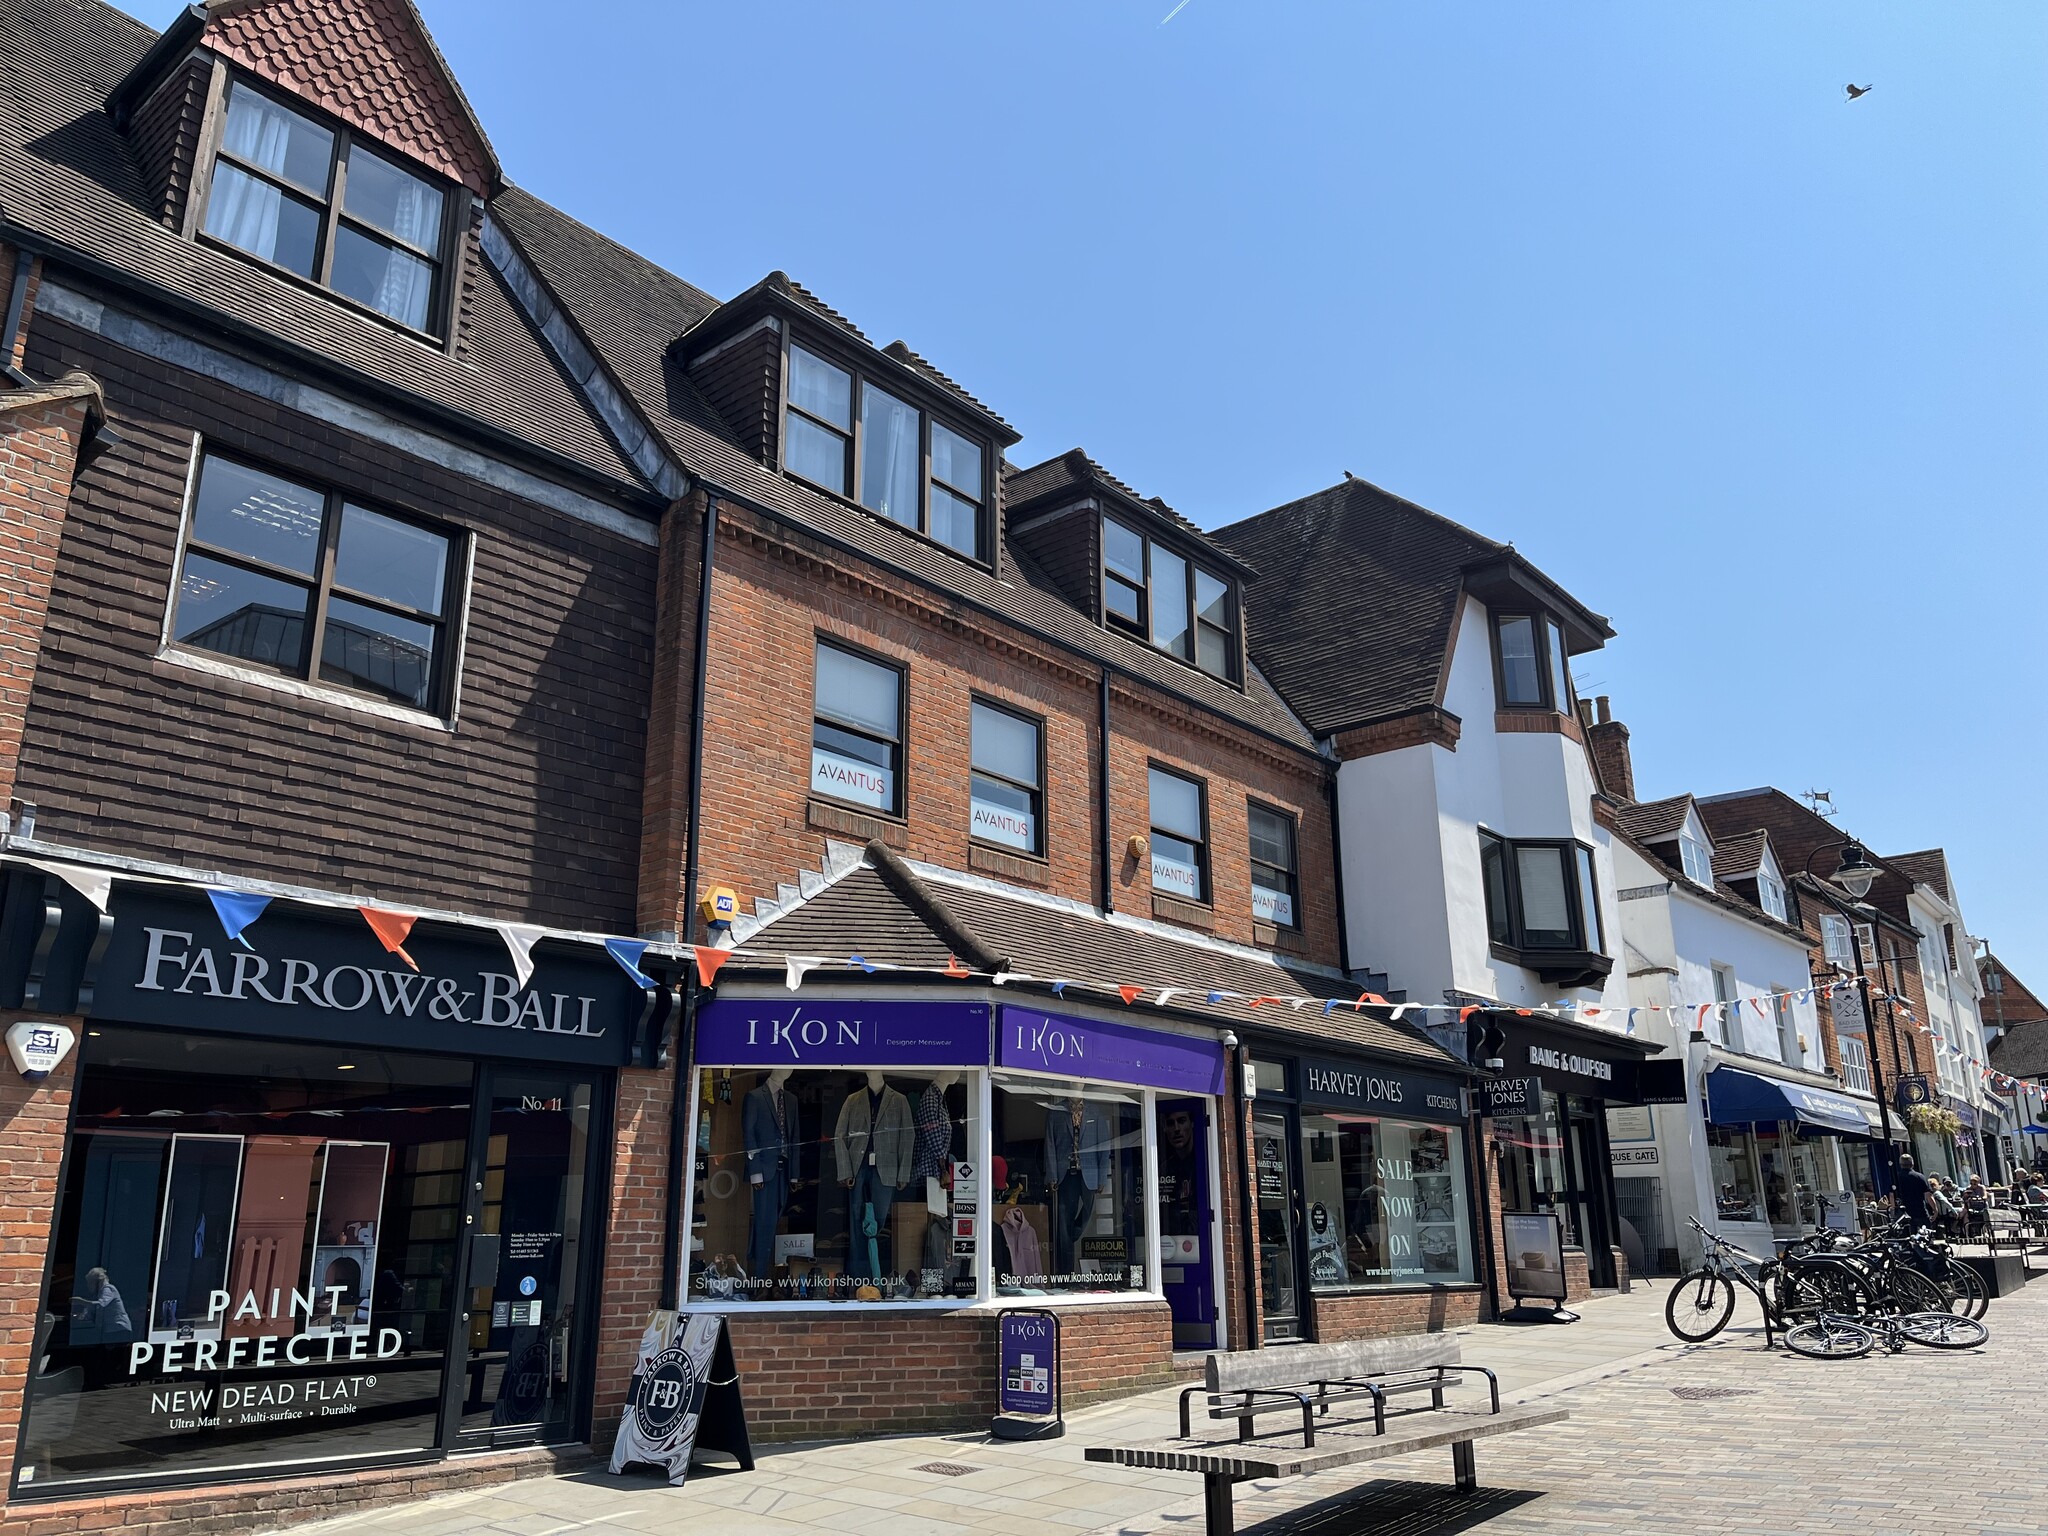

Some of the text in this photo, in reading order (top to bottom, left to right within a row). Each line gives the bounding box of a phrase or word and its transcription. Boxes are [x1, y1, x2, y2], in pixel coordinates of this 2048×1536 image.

[817, 763, 885, 794] AVANTUS
[974, 809, 1028, 837] AVANTUS
[1153, 864, 1195, 886] AVANTUS
[717, 898, 733, 910] ADT
[1252, 893, 1288, 914] AVANTUS
[746, 1007, 863, 1059] IKON
[886, 1038, 952, 1047] Designer Menswear
[1016, 1018, 1085, 1066] IKON
[1529, 1045, 1612, 1081] BANG & OLUFSEN
[1309, 1067, 1403, 1103] HARVEY JONES
[1484, 1078, 1530, 1093] HARVEY
[521, 1095, 563, 1112] No. 11
[1426, 1094, 1458, 1111] KITCHENS
[1491, 1091, 1526, 1107] JONES
[1492, 1107, 1527, 1116] KITCHENS
[1635, 1151, 1656, 1160] GATE
[1377, 1158, 1414, 1181] SALE
[955, 1204, 976, 1212] BOSS
[1380, 1196, 1414, 1218] NOW
[783, 1239, 805, 1249] SALE
[1084, 1241, 1124, 1251] BARBOUR
[1084, 1250, 1126, 1258] INTERNATIONAL
[1391, 1235, 1411, 1256] ON
[1000, 1270, 1123, 1286] Shop online www.ikonshop.co.uk
[1365, 1266, 1425, 1277] www.harveyjones.com
[695, 1275, 905, 1290] Shop online www.ikonshop.co.uk
[207, 1285, 348, 1322] PAINT
[1010, 1320, 1046, 1341] IKON
[129, 1328, 402, 1375] PERFECTED
[644, 1351, 693, 1391] FARROW & BALL
[151, 1389, 213, 1414] NEW
[222, 1383, 295, 1409] DEAD
[647, 1378, 682, 1410] F&B
[169, 1403, 357, 1430] Ultra Matt Multi-surface Durable
[639, 1408, 652, 1435] PAINT
[661, 1411, 683, 1436] PAPER
